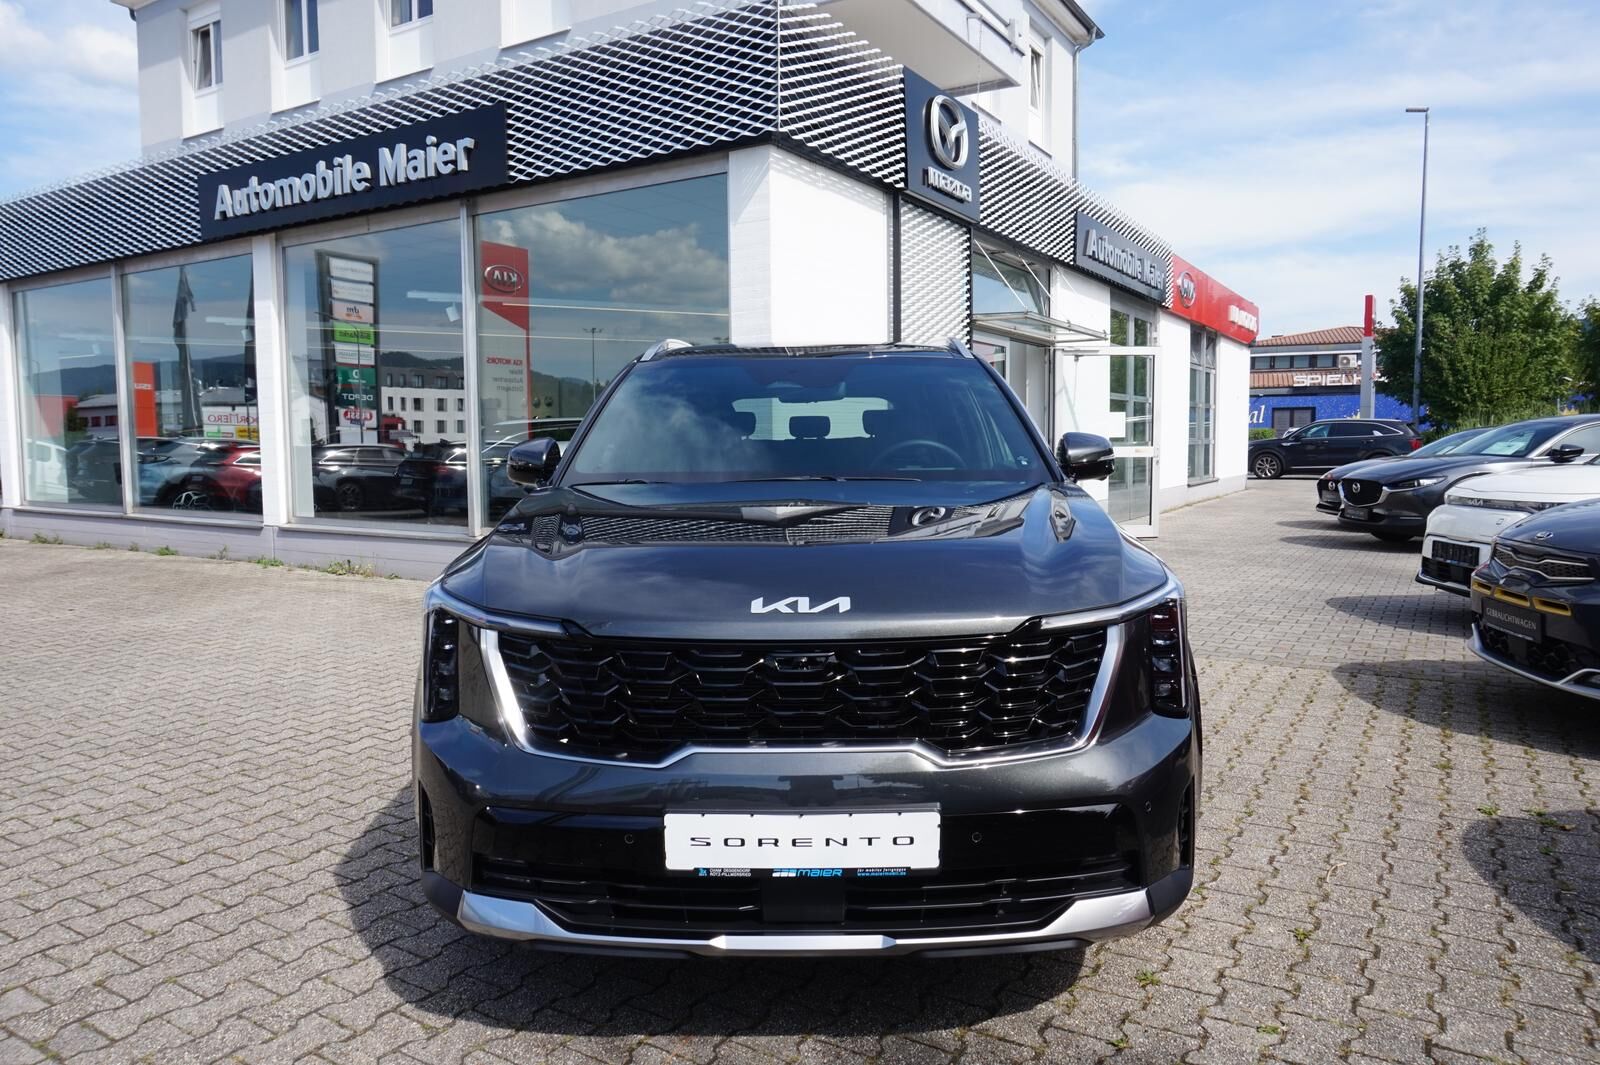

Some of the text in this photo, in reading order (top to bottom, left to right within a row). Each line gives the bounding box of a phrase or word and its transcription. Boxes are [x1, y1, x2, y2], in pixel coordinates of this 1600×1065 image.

[214, 135, 475, 220] Automobile Maier
[927, 166, 972, 202] mazda
[1085, 229, 1165, 290] Automobile Maier
[1293, 373, 1361, 387] SPIELH
[1248, 404, 1265, 423] al
[750, 596, 851, 614] KIA
[689, 836, 915, 848] SORENTO
